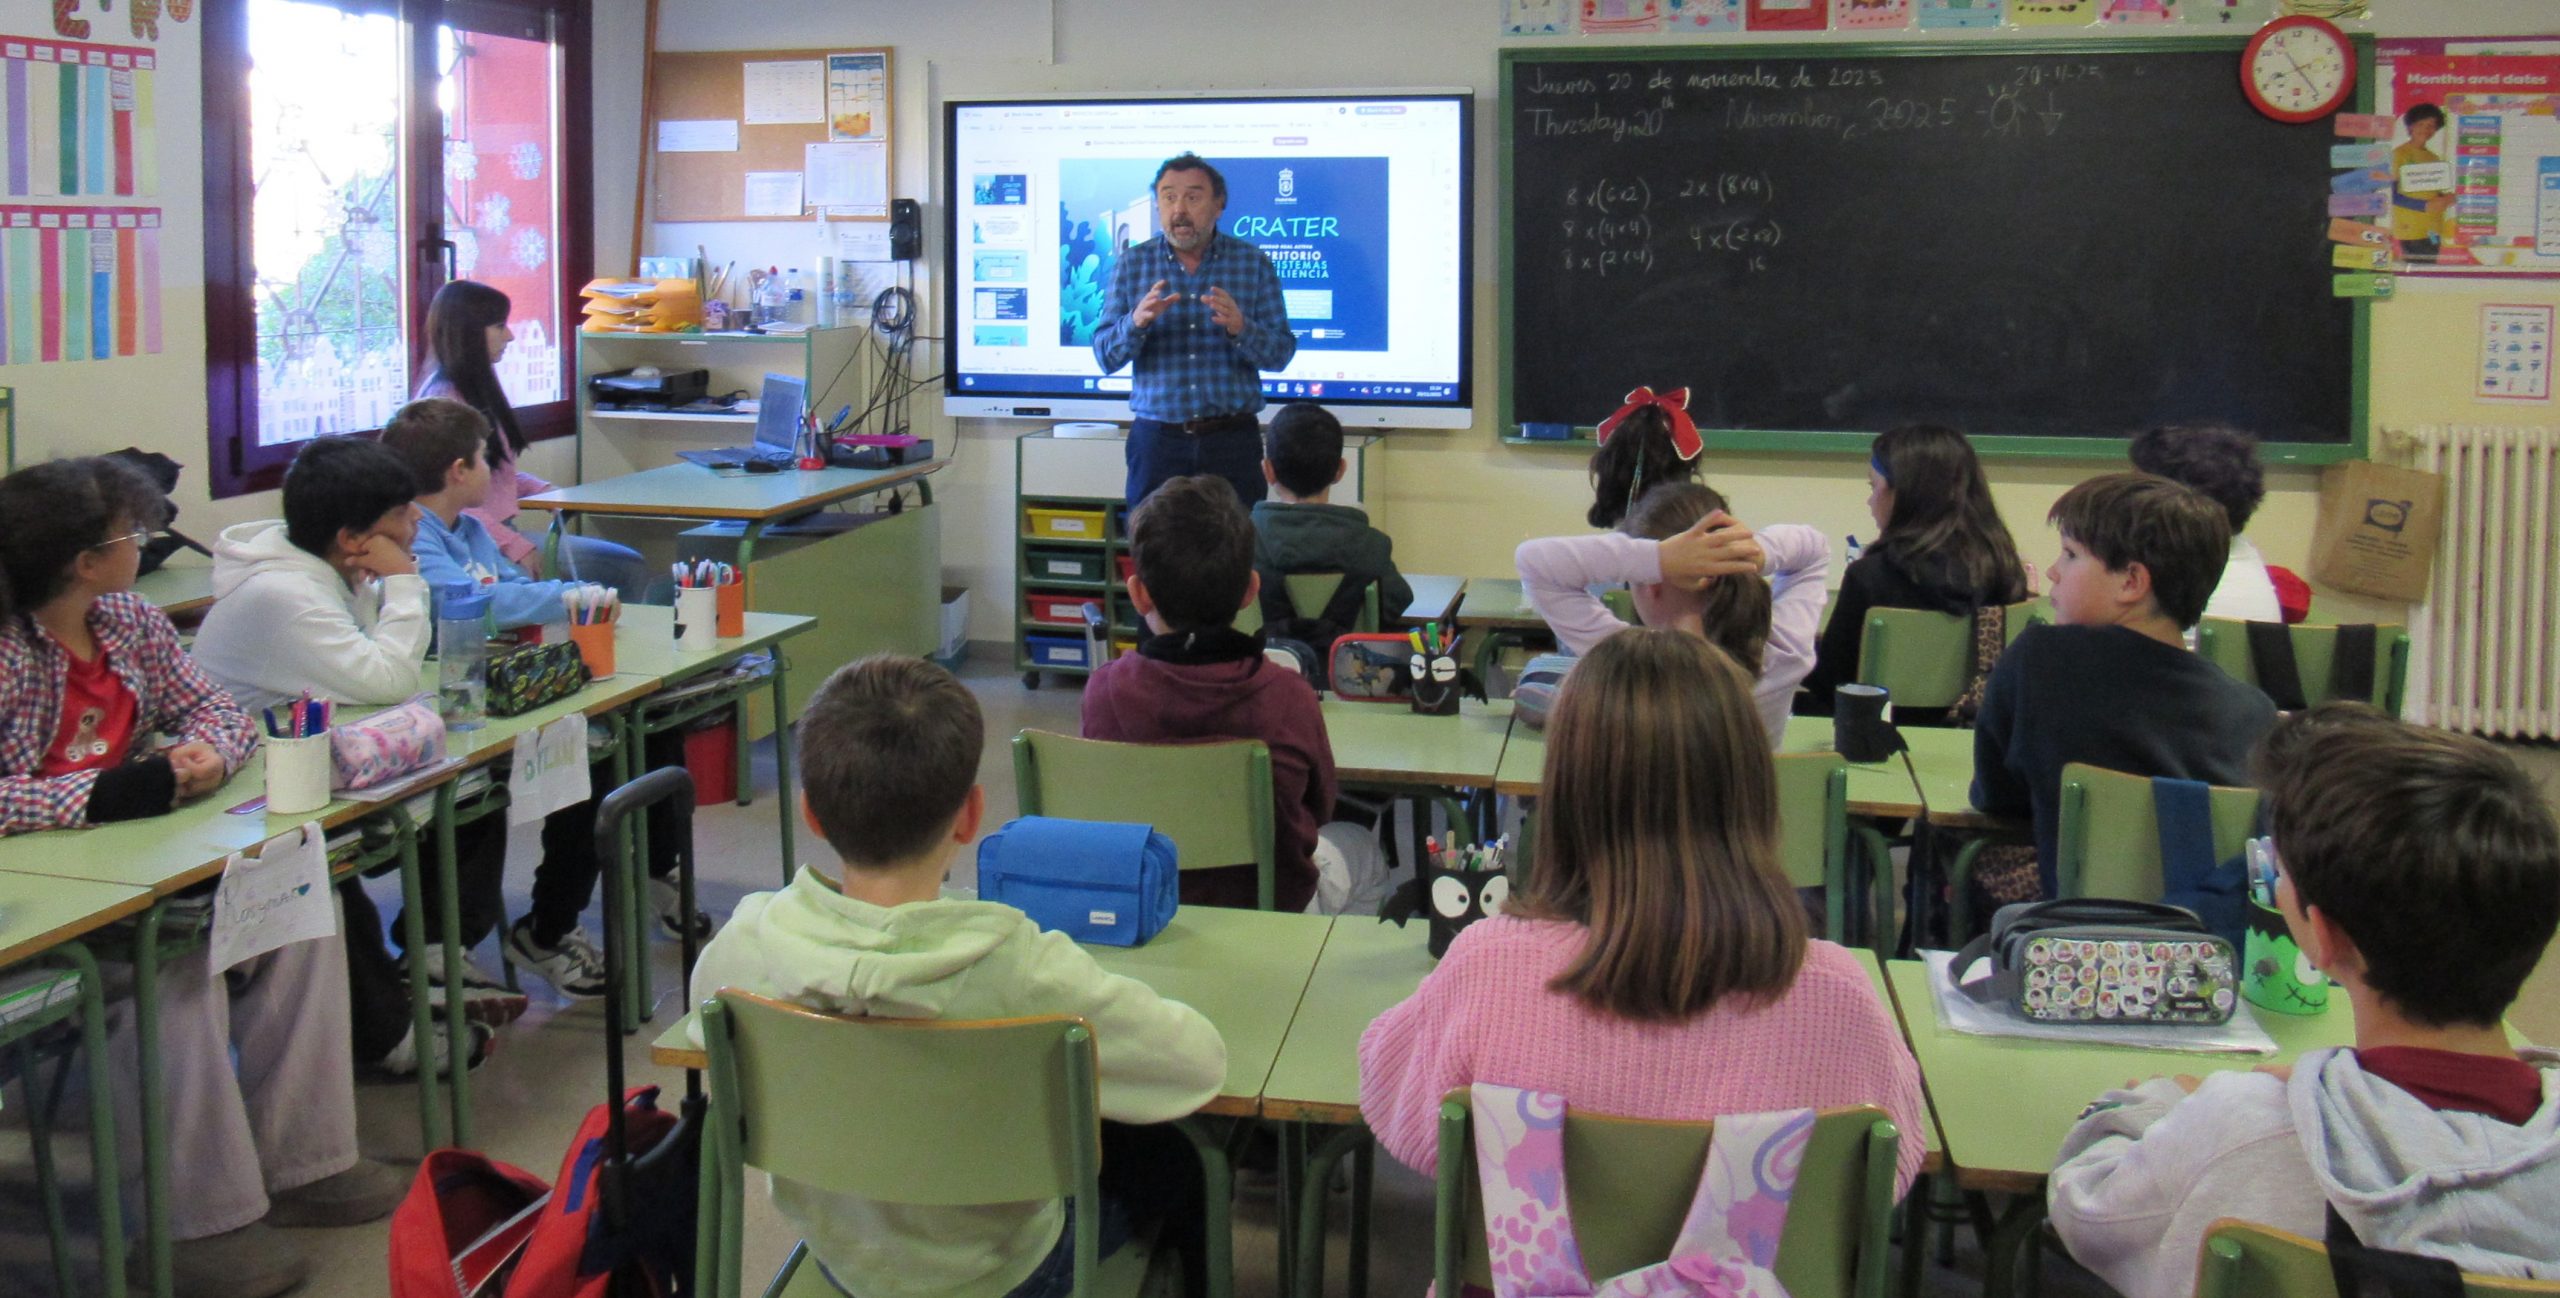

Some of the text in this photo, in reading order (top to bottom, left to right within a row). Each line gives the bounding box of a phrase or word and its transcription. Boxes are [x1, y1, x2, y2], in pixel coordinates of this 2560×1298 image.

[1608, 72, 1632, 91] 20
[1648, 68, 1673, 90] de
[1790, 65, 1814, 88] de
[1828, 67, 1885, 87] 2025
[2407, 73, 2547, 84] Months and dates
[1865, 97, 1955, 129] 2025
[1567, 188, 1577, 205] 8
[1233, 215, 1340, 238] CRATER
[1276, 270, 1330, 279] ILIENCIA
